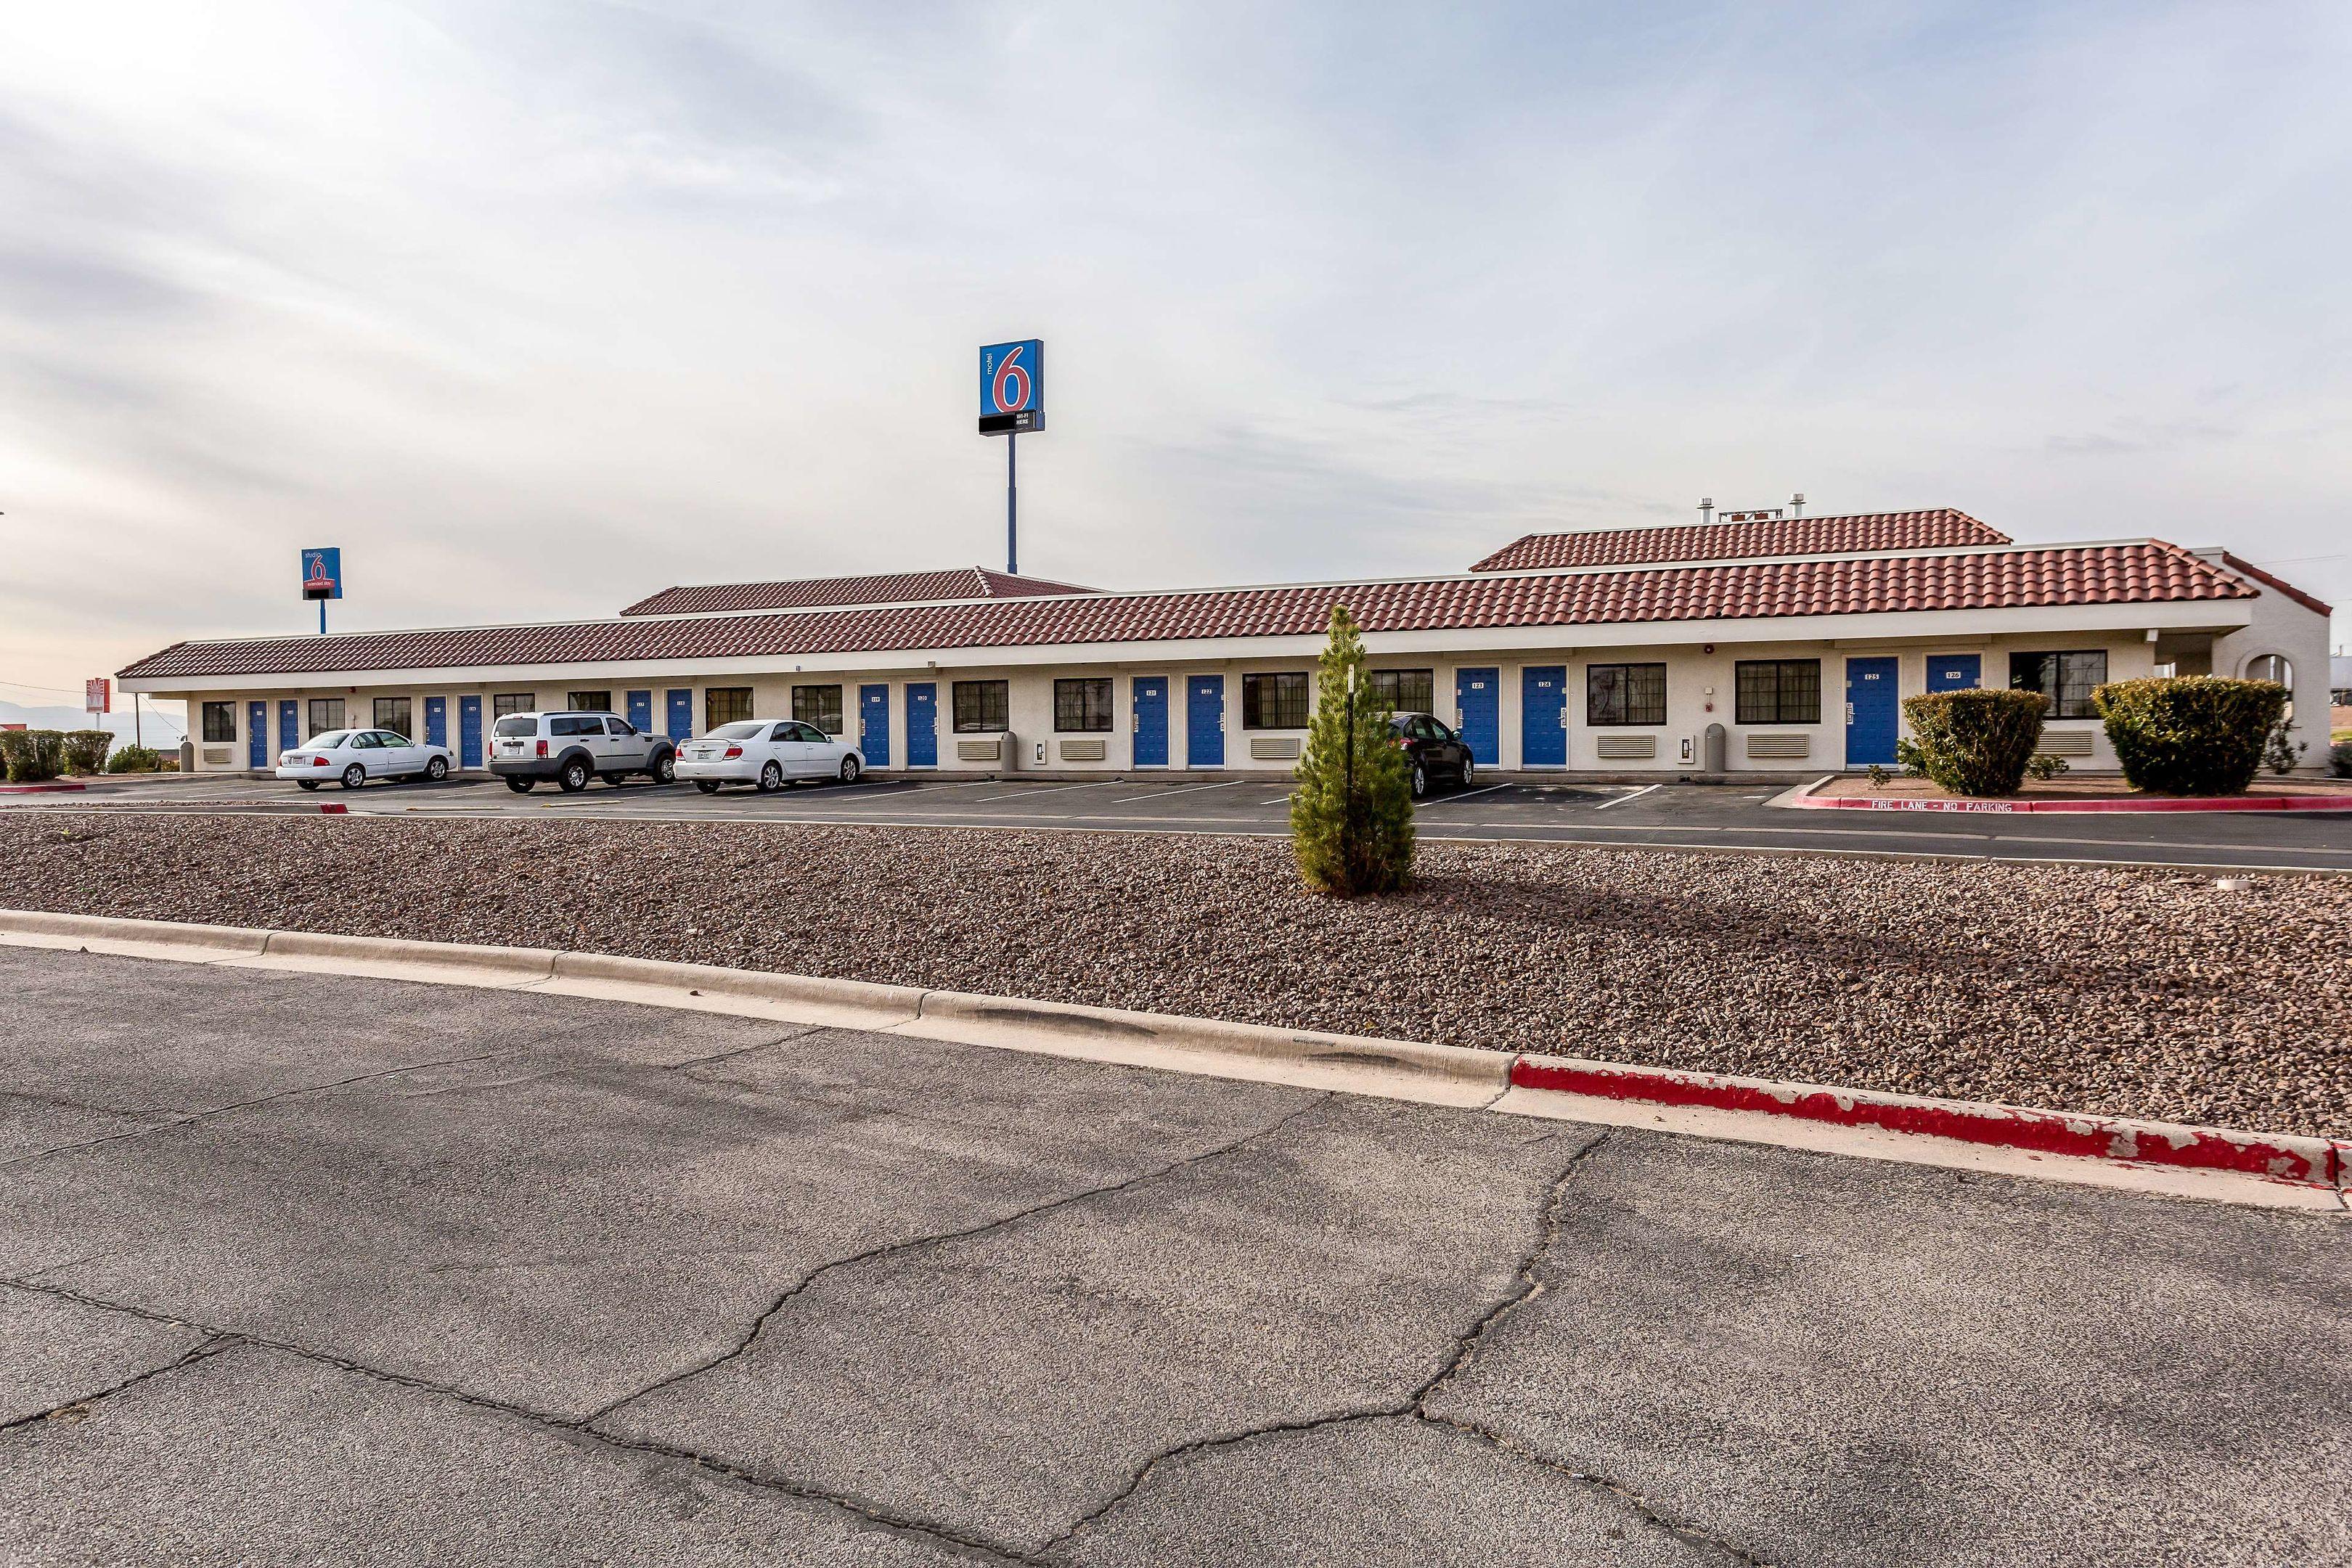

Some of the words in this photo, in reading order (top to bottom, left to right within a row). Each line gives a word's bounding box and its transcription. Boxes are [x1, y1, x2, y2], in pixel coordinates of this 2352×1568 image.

[992, 346, 1031, 413] 6
[311, 555, 326, 581] 6
[1871, 800, 1893, 809] FIRE
[1900, 801, 1928, 810] LANE
[1943, 801, 1958, 811] NO
[1966, 802, 2012, 812] PARKING
